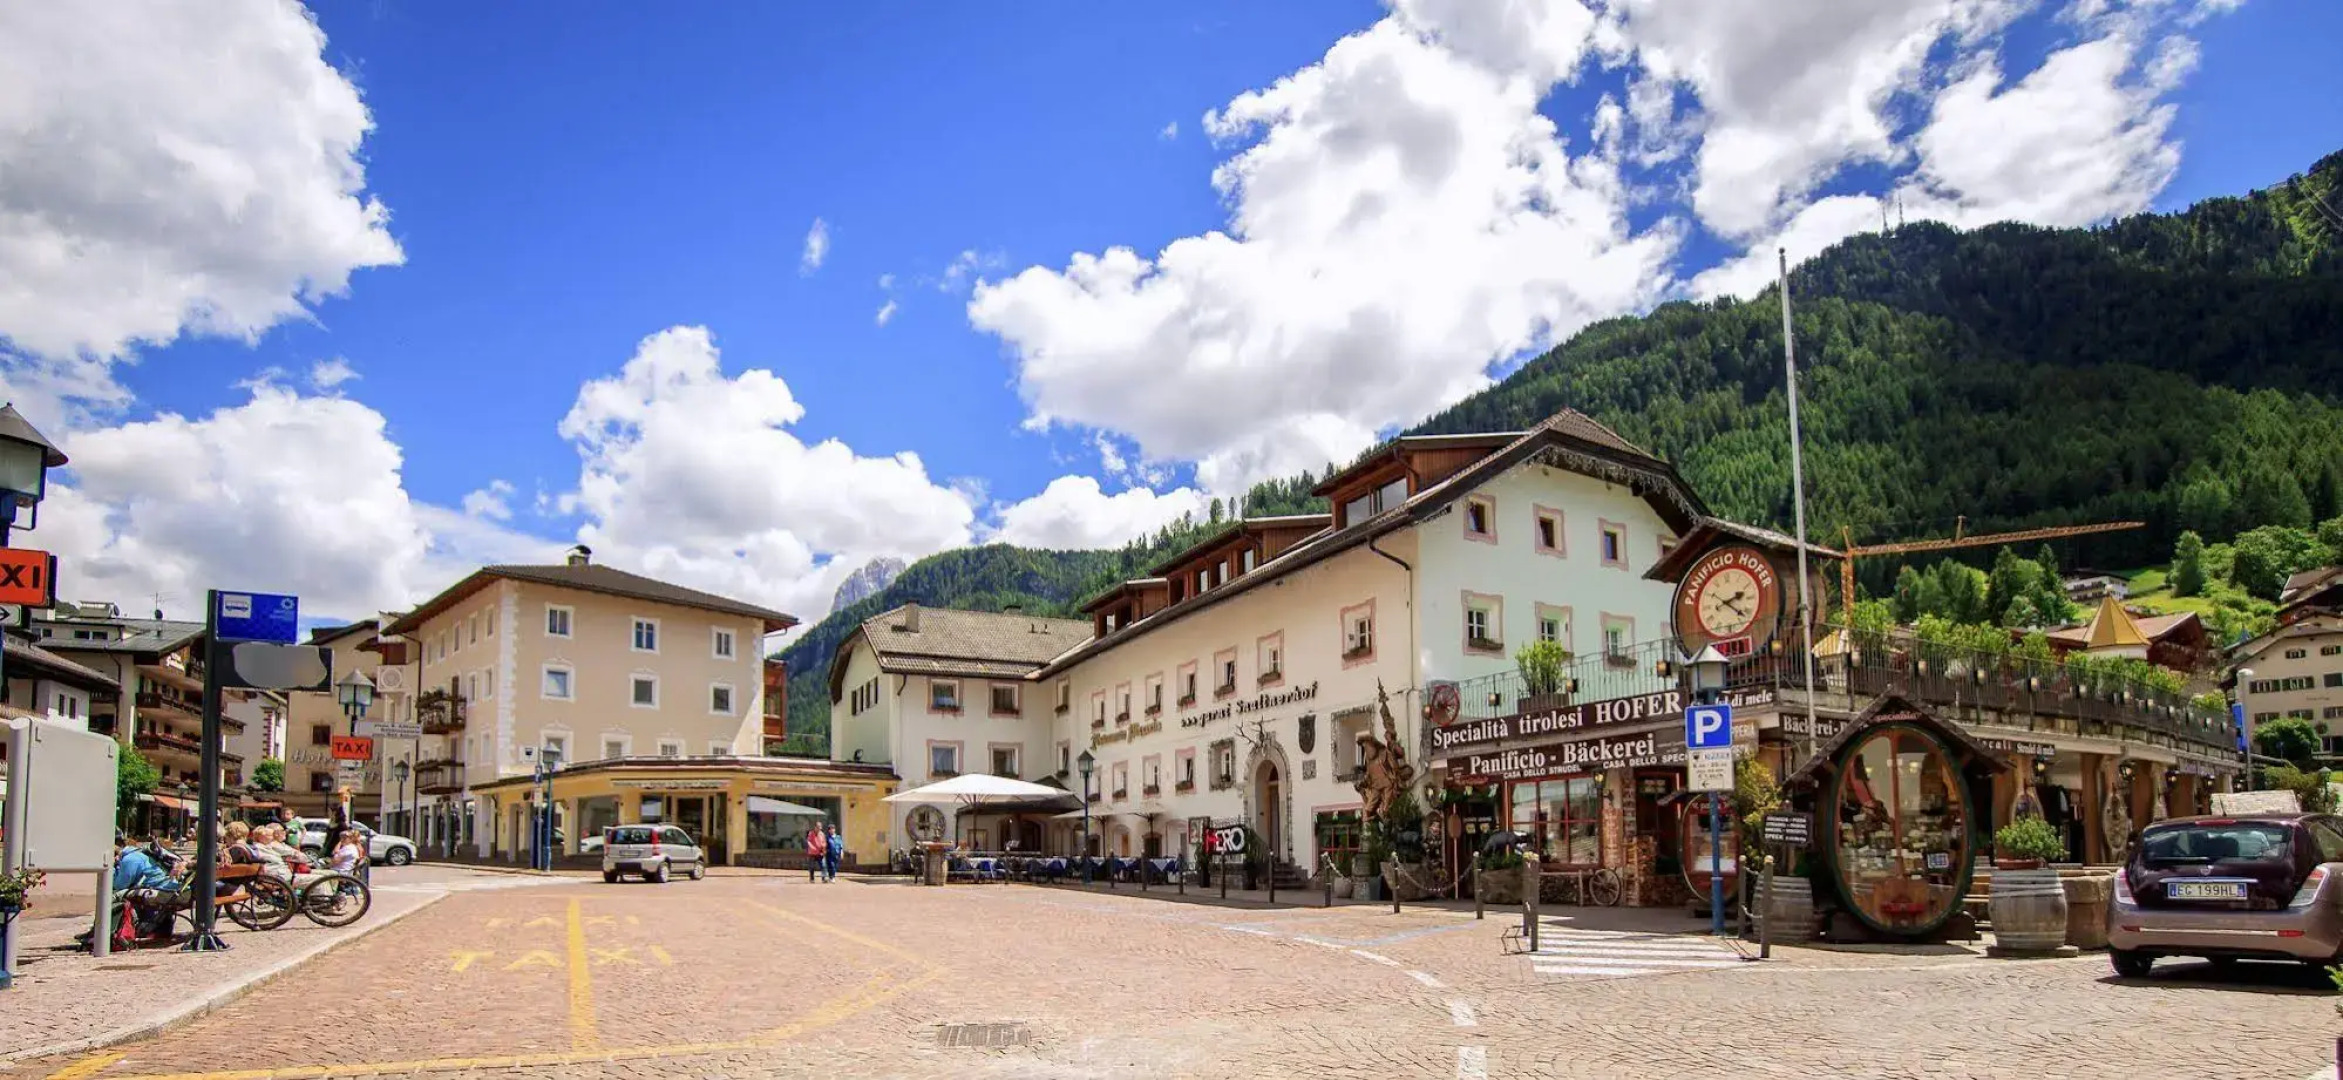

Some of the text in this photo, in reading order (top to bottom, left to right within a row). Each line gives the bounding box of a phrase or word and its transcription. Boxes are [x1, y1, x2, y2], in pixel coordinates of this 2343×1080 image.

[1684, 552, 1773, 605] PANIFICIO HOFER
[1745, 689, 1773, 705] mele
[1433, 690, 1683, 750] Specialità tirolesi HOFER
[1694, 710, 1723, 745] P
[334, 741, 370, 754] TAXI
[1470, 748, 1546, 775] Panificio
[1563, 733, 1656, 765] Bäckerei
[1503, 763, 1582, 779] CASA DELLO STRUDEL
[1602, 758, 1626, 770] CASA
[1629, 755, 1658, 767] DELLO
[2198, 885, 2237, 897] 199HL
[449, 944, 673, 973] TAXI
